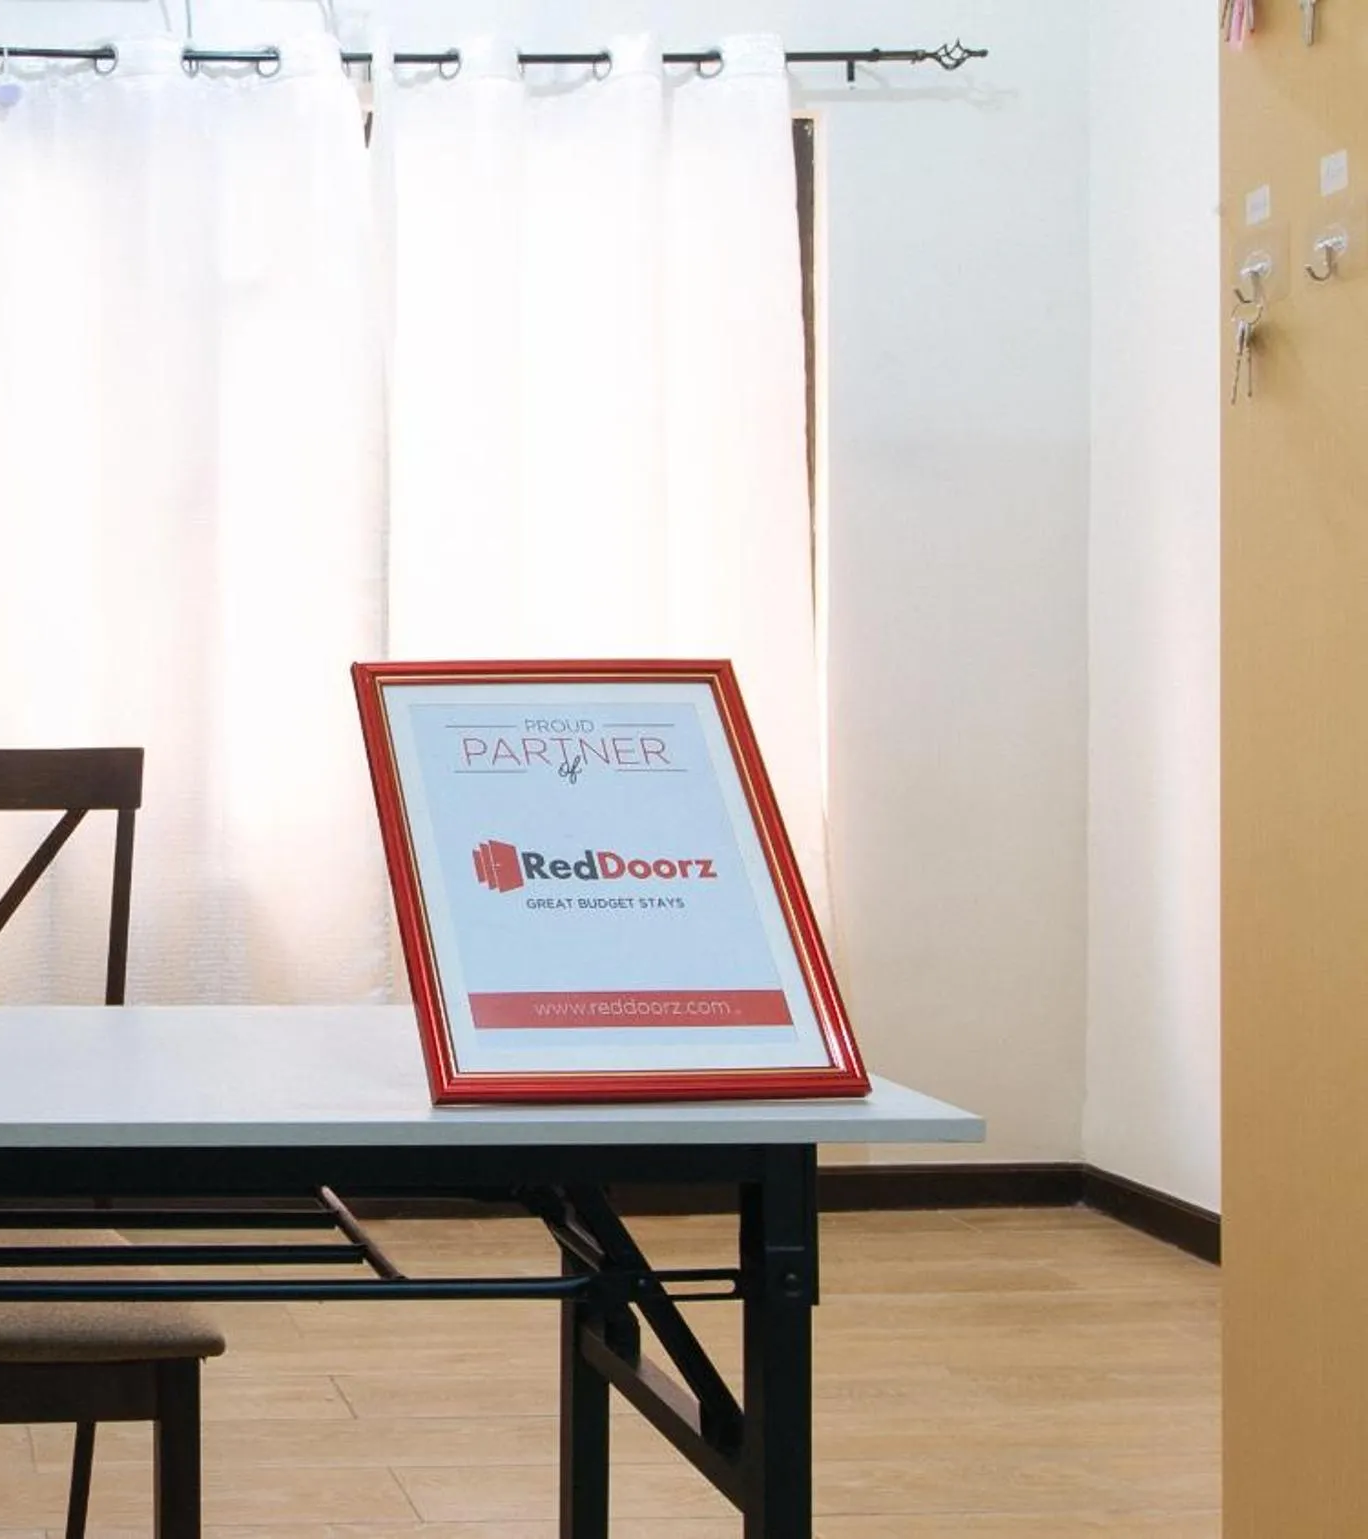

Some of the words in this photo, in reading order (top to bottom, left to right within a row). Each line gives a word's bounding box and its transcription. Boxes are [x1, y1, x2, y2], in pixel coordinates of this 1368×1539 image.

[524, 718, 595, 733] PROUD
[462, 737, 671, 766] PARTNER
[558, 755, 583, 784] of
[521, 850, 717, 880] RedDoorz
[526, 898, 573, 909] GREAT
[578, 898, 634, 909] BUDGET
[639, 898, 685, 909] STAYS
[532, 999, 731, 1017] www.reddoorz.com
